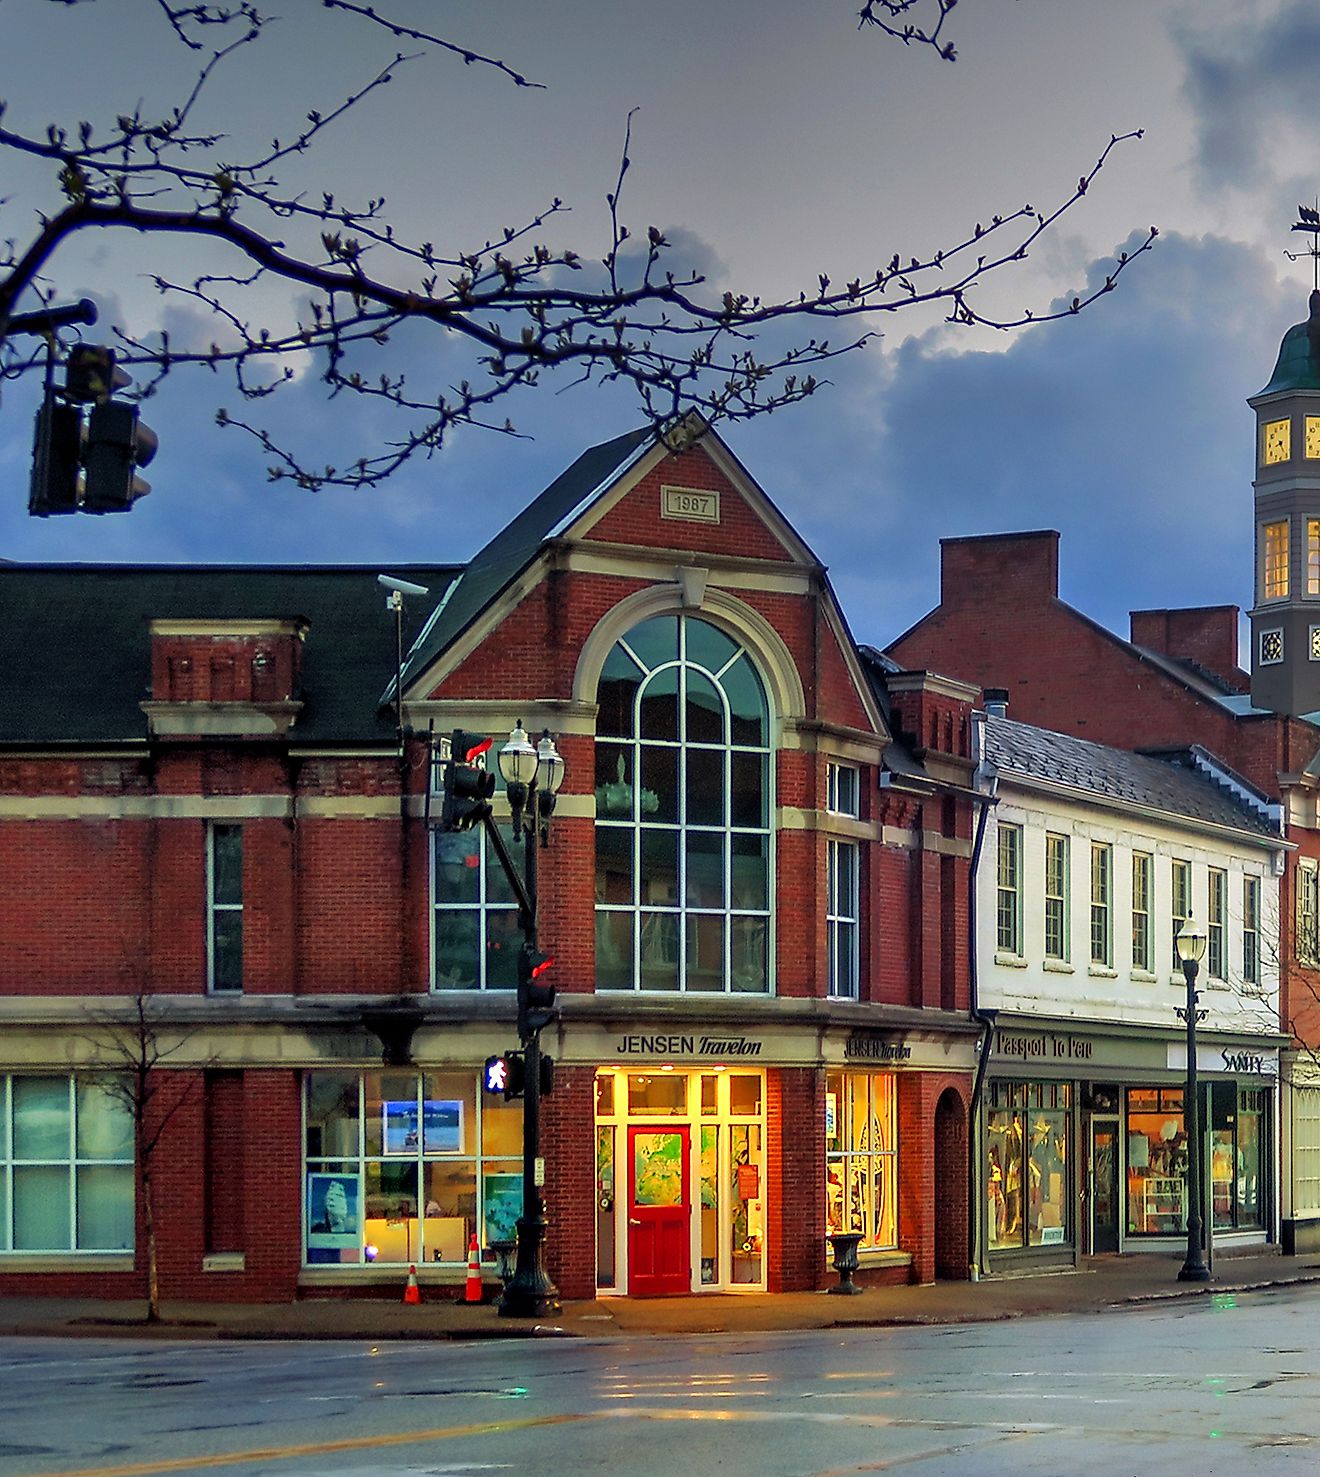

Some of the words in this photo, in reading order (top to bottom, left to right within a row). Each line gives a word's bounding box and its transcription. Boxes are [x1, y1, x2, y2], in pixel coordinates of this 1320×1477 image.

[674, 496, 709, 513] 1987
[617, 1035, 694, 1054] JENSEN
[699, 1036, 762, 1056] Travelon
[844, 1039, 880, 1058] JENSEN
[997, 1032, 1046, 1060] Passport
[1051, 1035, 1065, 1057] To
[1068, 1036, 1092, 1059] Peru
